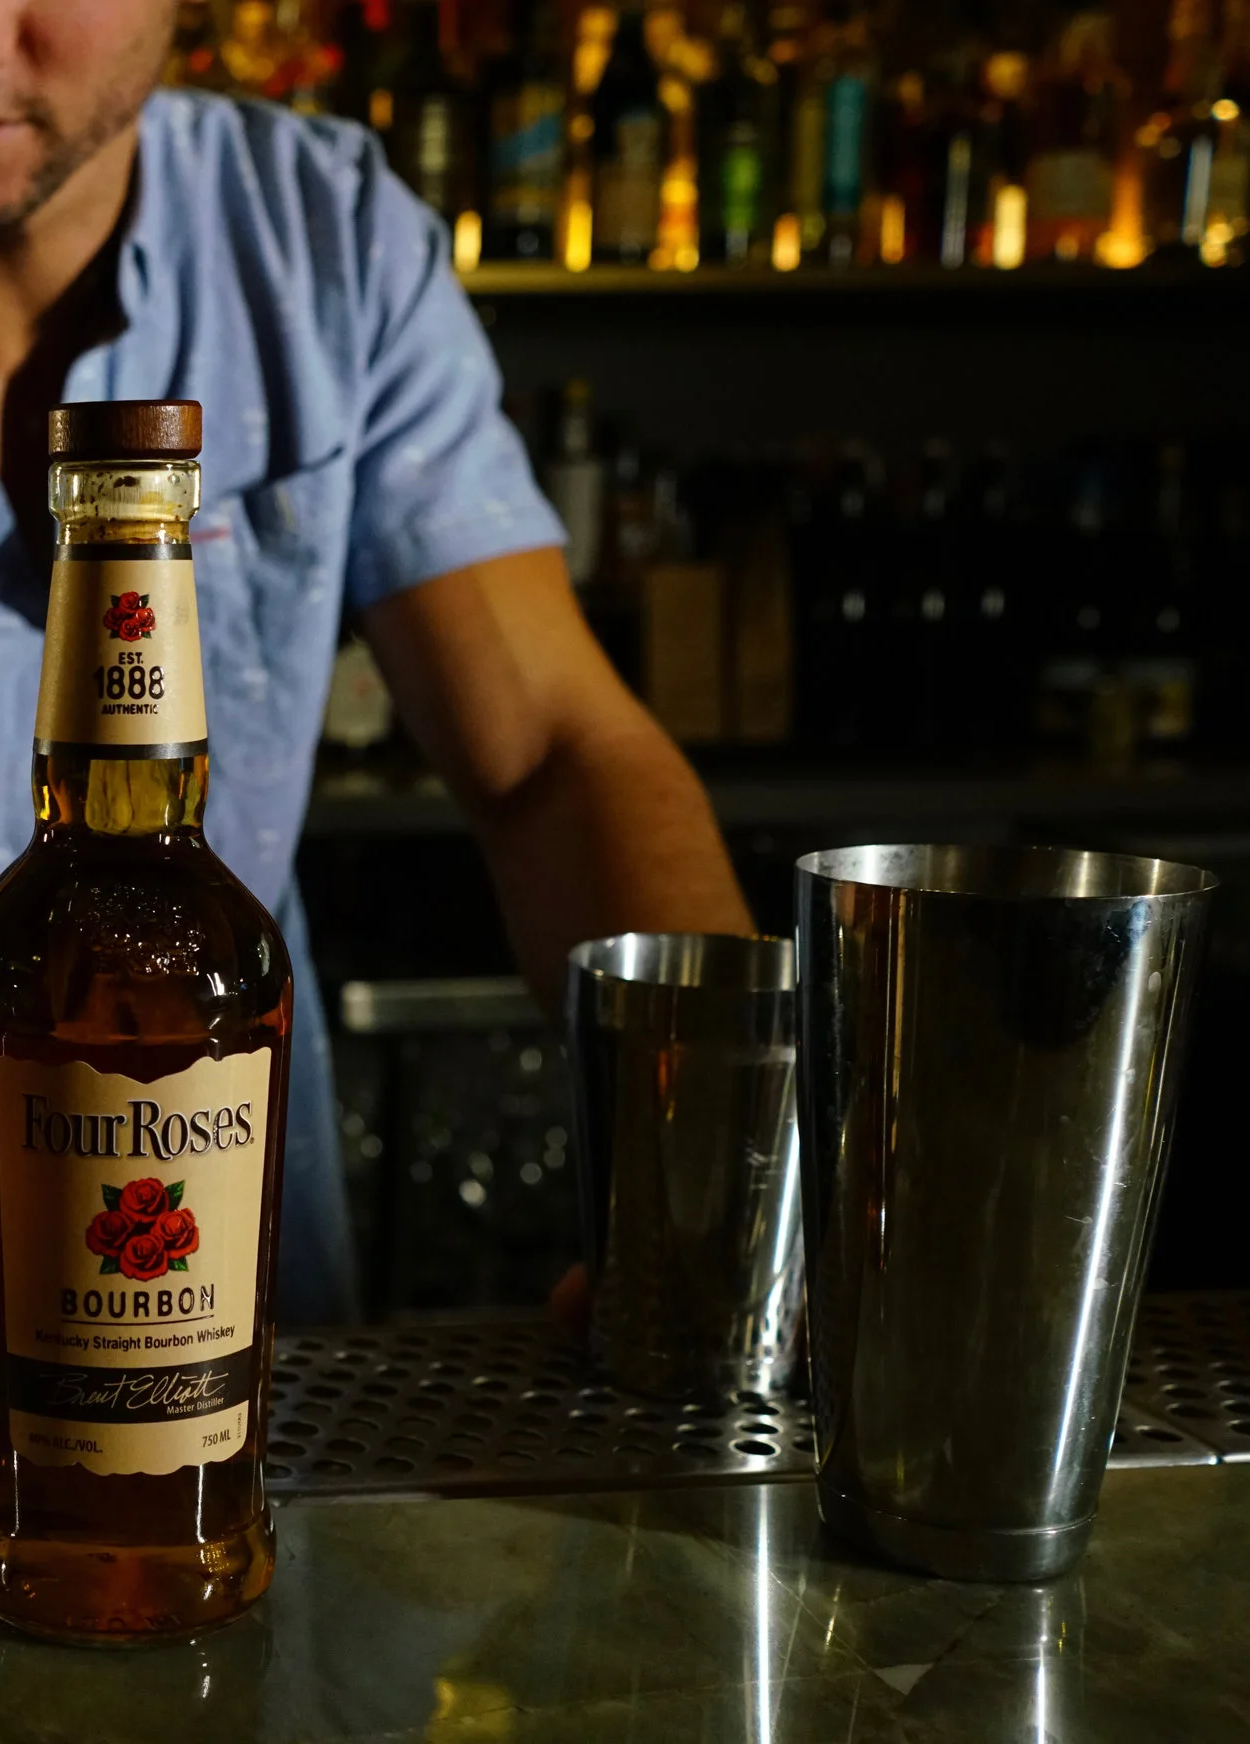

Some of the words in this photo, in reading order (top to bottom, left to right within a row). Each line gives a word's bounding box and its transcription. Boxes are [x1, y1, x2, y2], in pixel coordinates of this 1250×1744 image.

[118, 651, 144, 665] EST.
[91, 665, 166, 700] 1888
[101, 703, 159, 715] AUTHENTIC
[21, 1093, 127, 1158] Four
[60, 1283, 215, 1319] BOURBON
[35, 1328, 90, 1351] Kentucky
[92, 1335, 141, 1352] Straight
[145, 1335, 194, 1350] Bourbon
[197, 1325, 235, 1343] Whiskey
[166, 1403, 194, 1415] Master
[196, 1396, 225, 1411] Distiller
[201, 1432, 218, 1448] 750
[219, 1429, 232, 1443] ML
